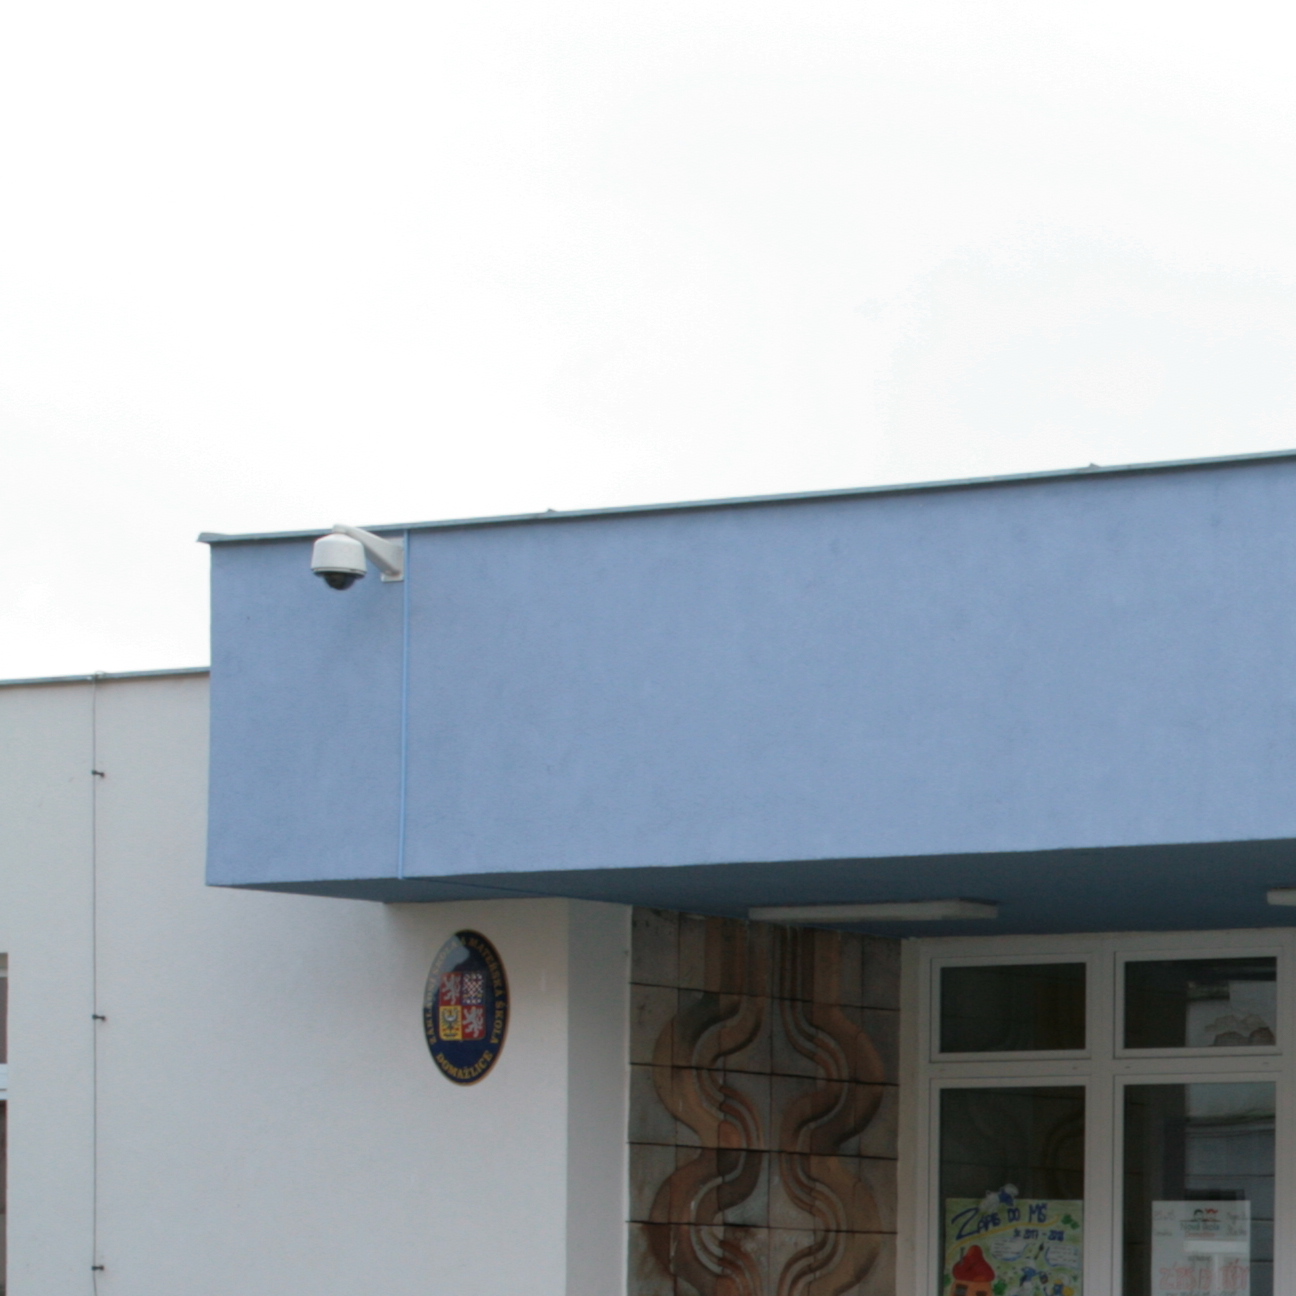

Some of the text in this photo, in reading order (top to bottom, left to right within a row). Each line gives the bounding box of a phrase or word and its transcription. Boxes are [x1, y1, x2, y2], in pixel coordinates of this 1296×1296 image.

[490, 1000, 505, 1044] ŠKOLA
[436, 1050, 494, 1079] DOMAŽLICE
[1007, 1207, 1020, 1223] DO
